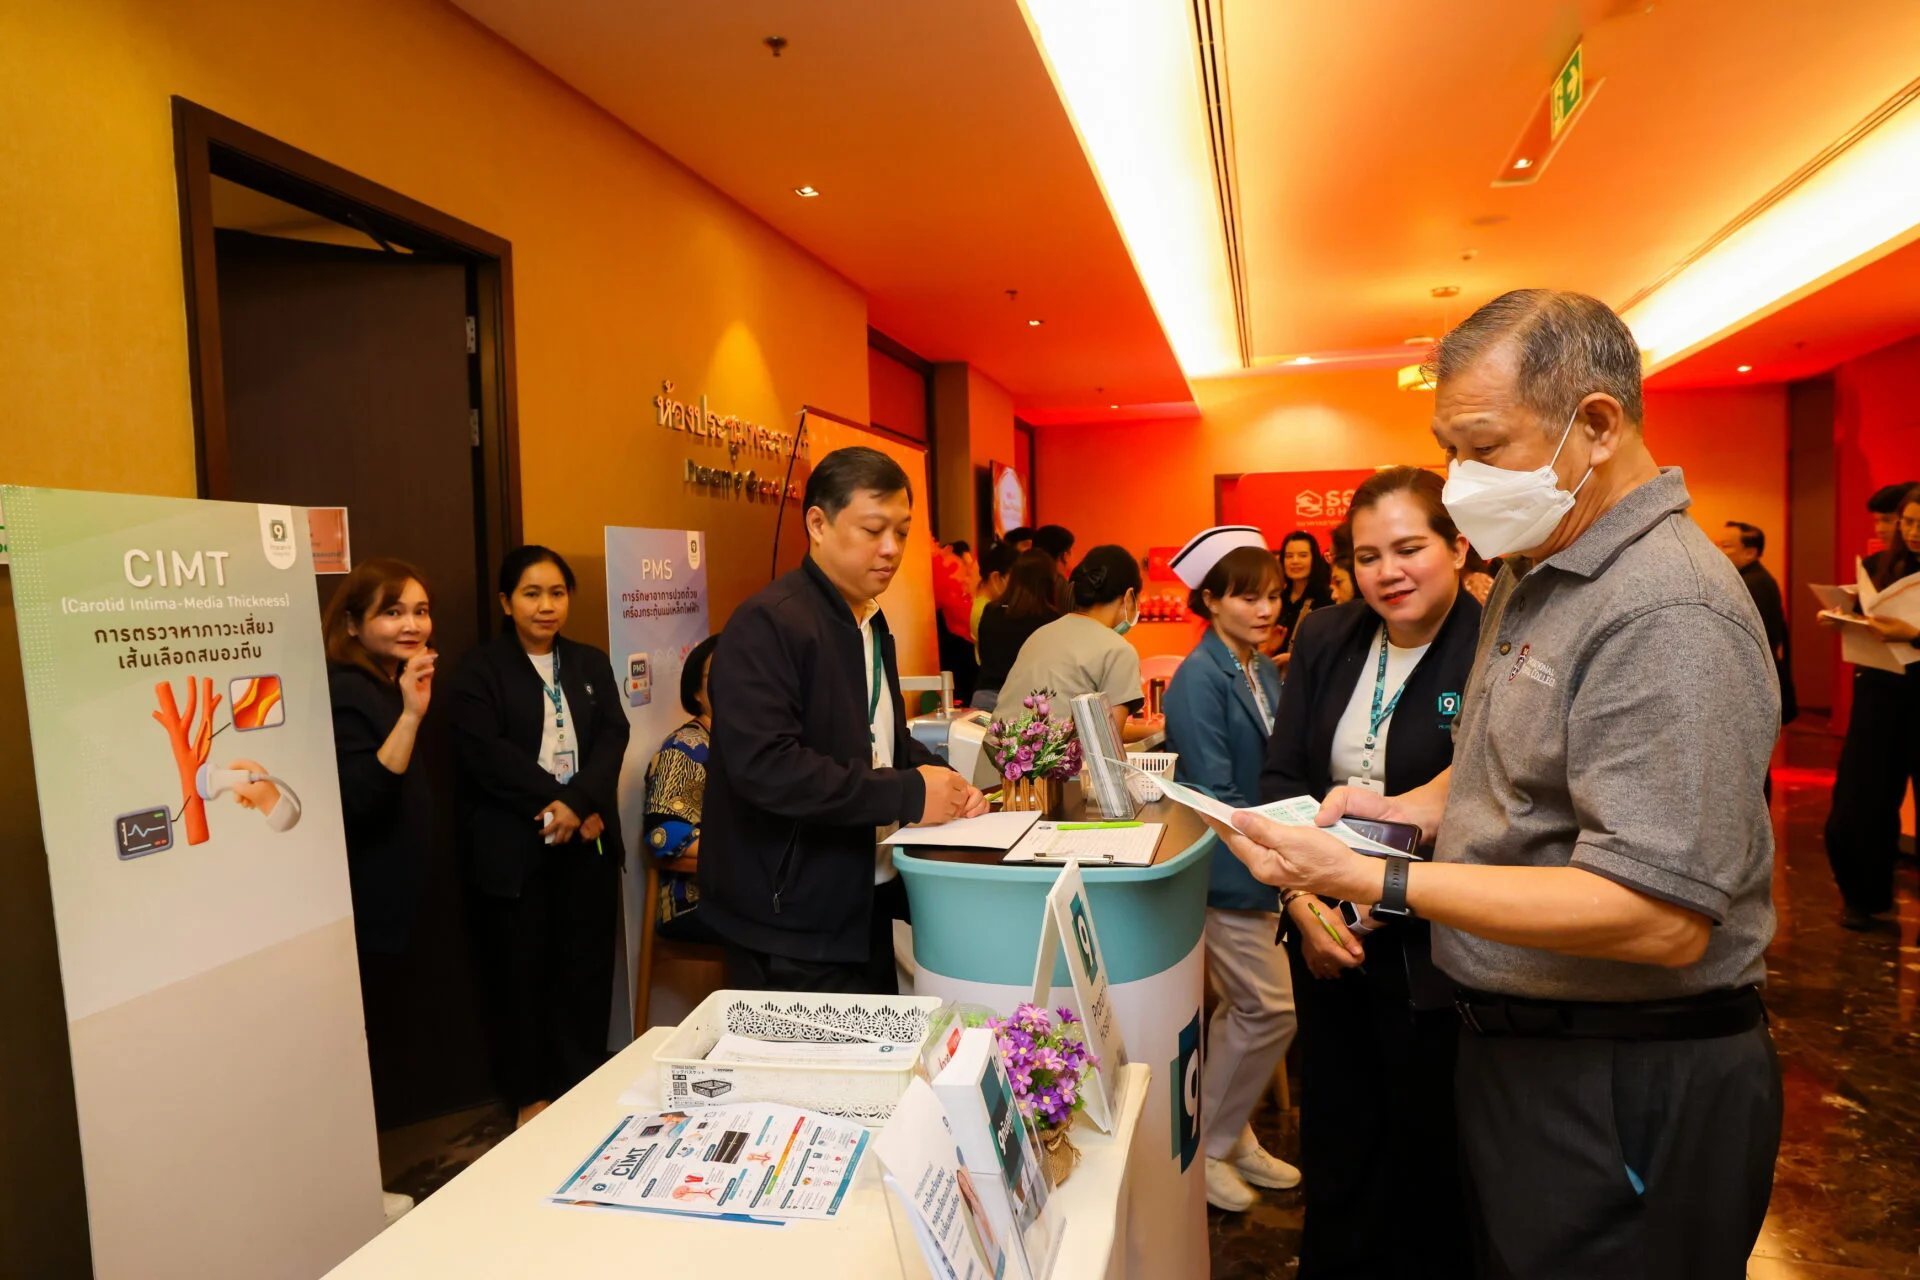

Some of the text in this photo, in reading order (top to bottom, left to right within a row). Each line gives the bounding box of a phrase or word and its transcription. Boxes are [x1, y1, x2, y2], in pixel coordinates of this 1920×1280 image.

[274, 525, 283, 539] 9
[124, 549, 229, 588] CIMT
[642, 559, 673, 580] PMS
[61, 593, 290, 614] (Carotid Intima-Media Thickness)
[95, 613, 274, 643] การตรวจหาภาวะเสี่ยง
[118, 641, 263, 670] เส้นเลือดสมองตีบ
[632, 663, 645, 674] PMS
[1443, 697, 1455, 712] 9
[1077, 914, 1094, 968] 9
[1184, 1048, 1199, 1139] 9
[611, 1147, 647, 1177] CIMT
